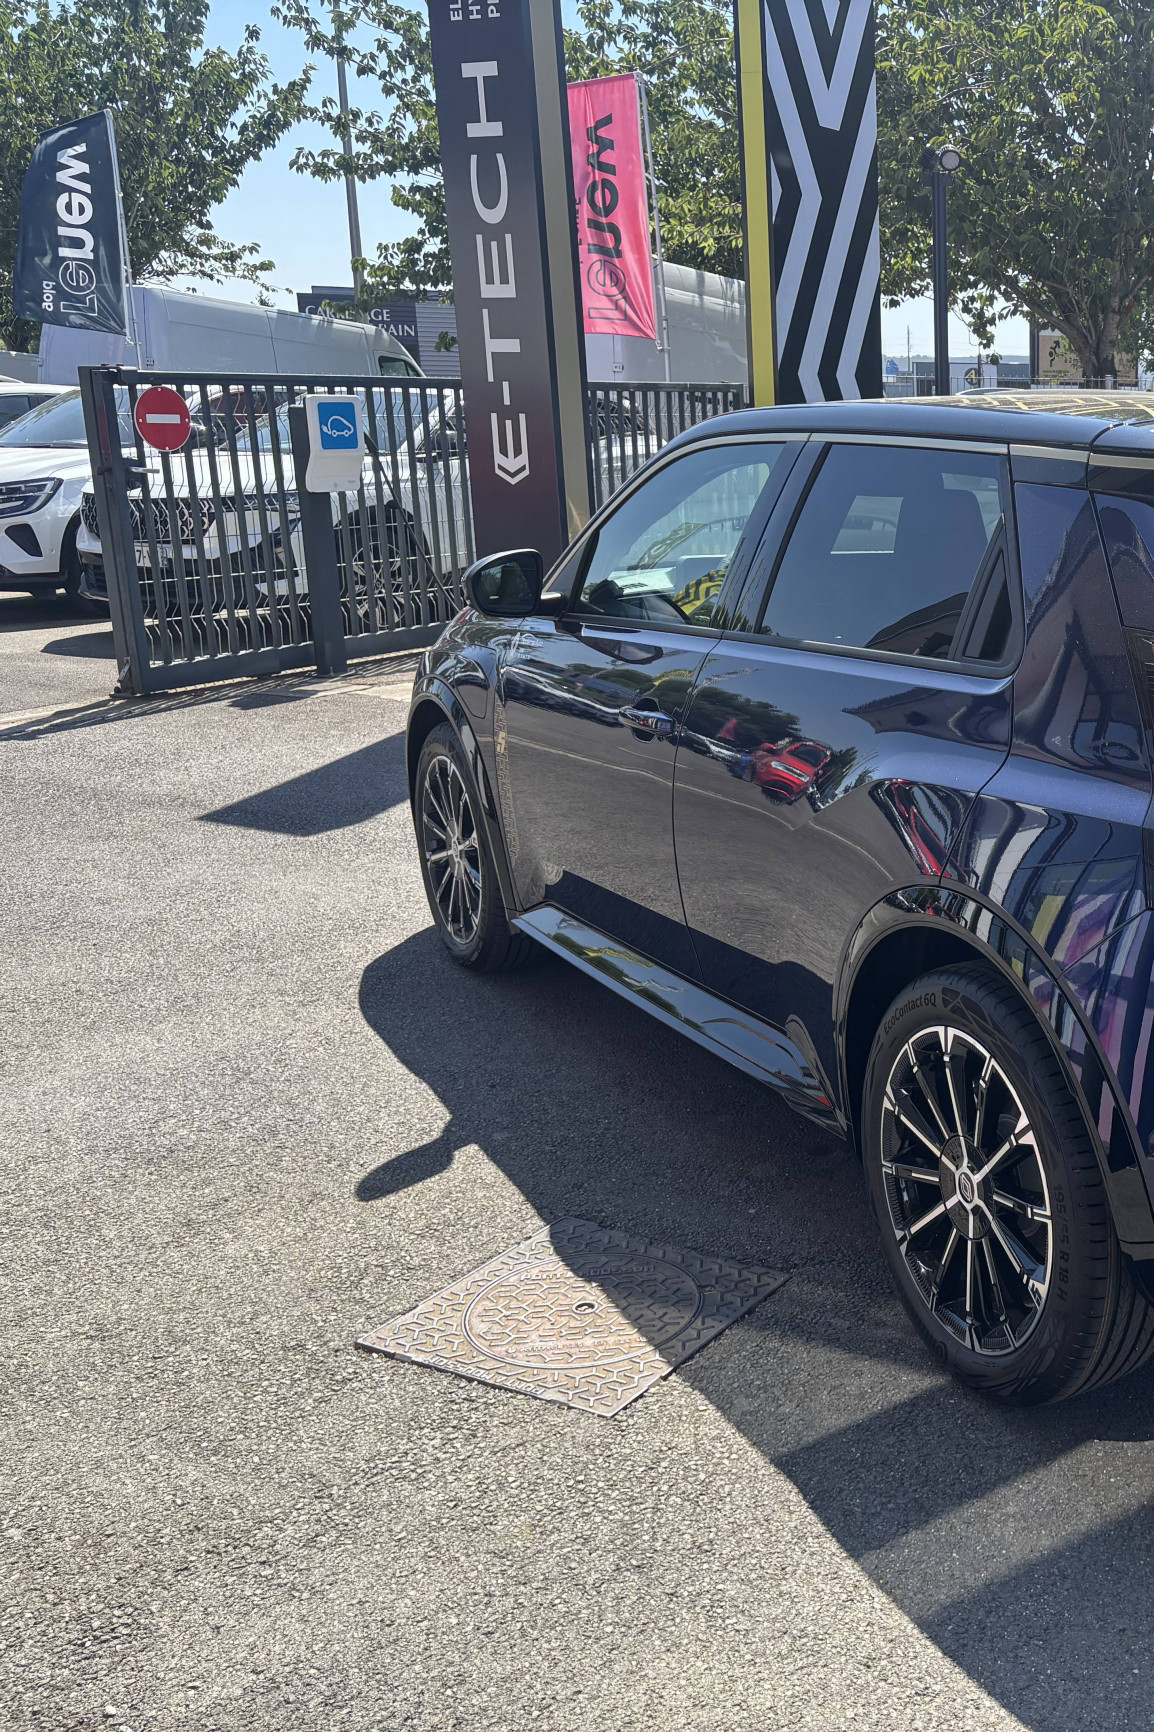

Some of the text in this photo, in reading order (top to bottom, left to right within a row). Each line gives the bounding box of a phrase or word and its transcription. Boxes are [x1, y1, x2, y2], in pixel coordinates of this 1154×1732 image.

[461, 60, 530, 485] E-TECH
[305, 305, 391, 321] CARREGE
[883, 992, 937, 1035] EcoContact 6Q
